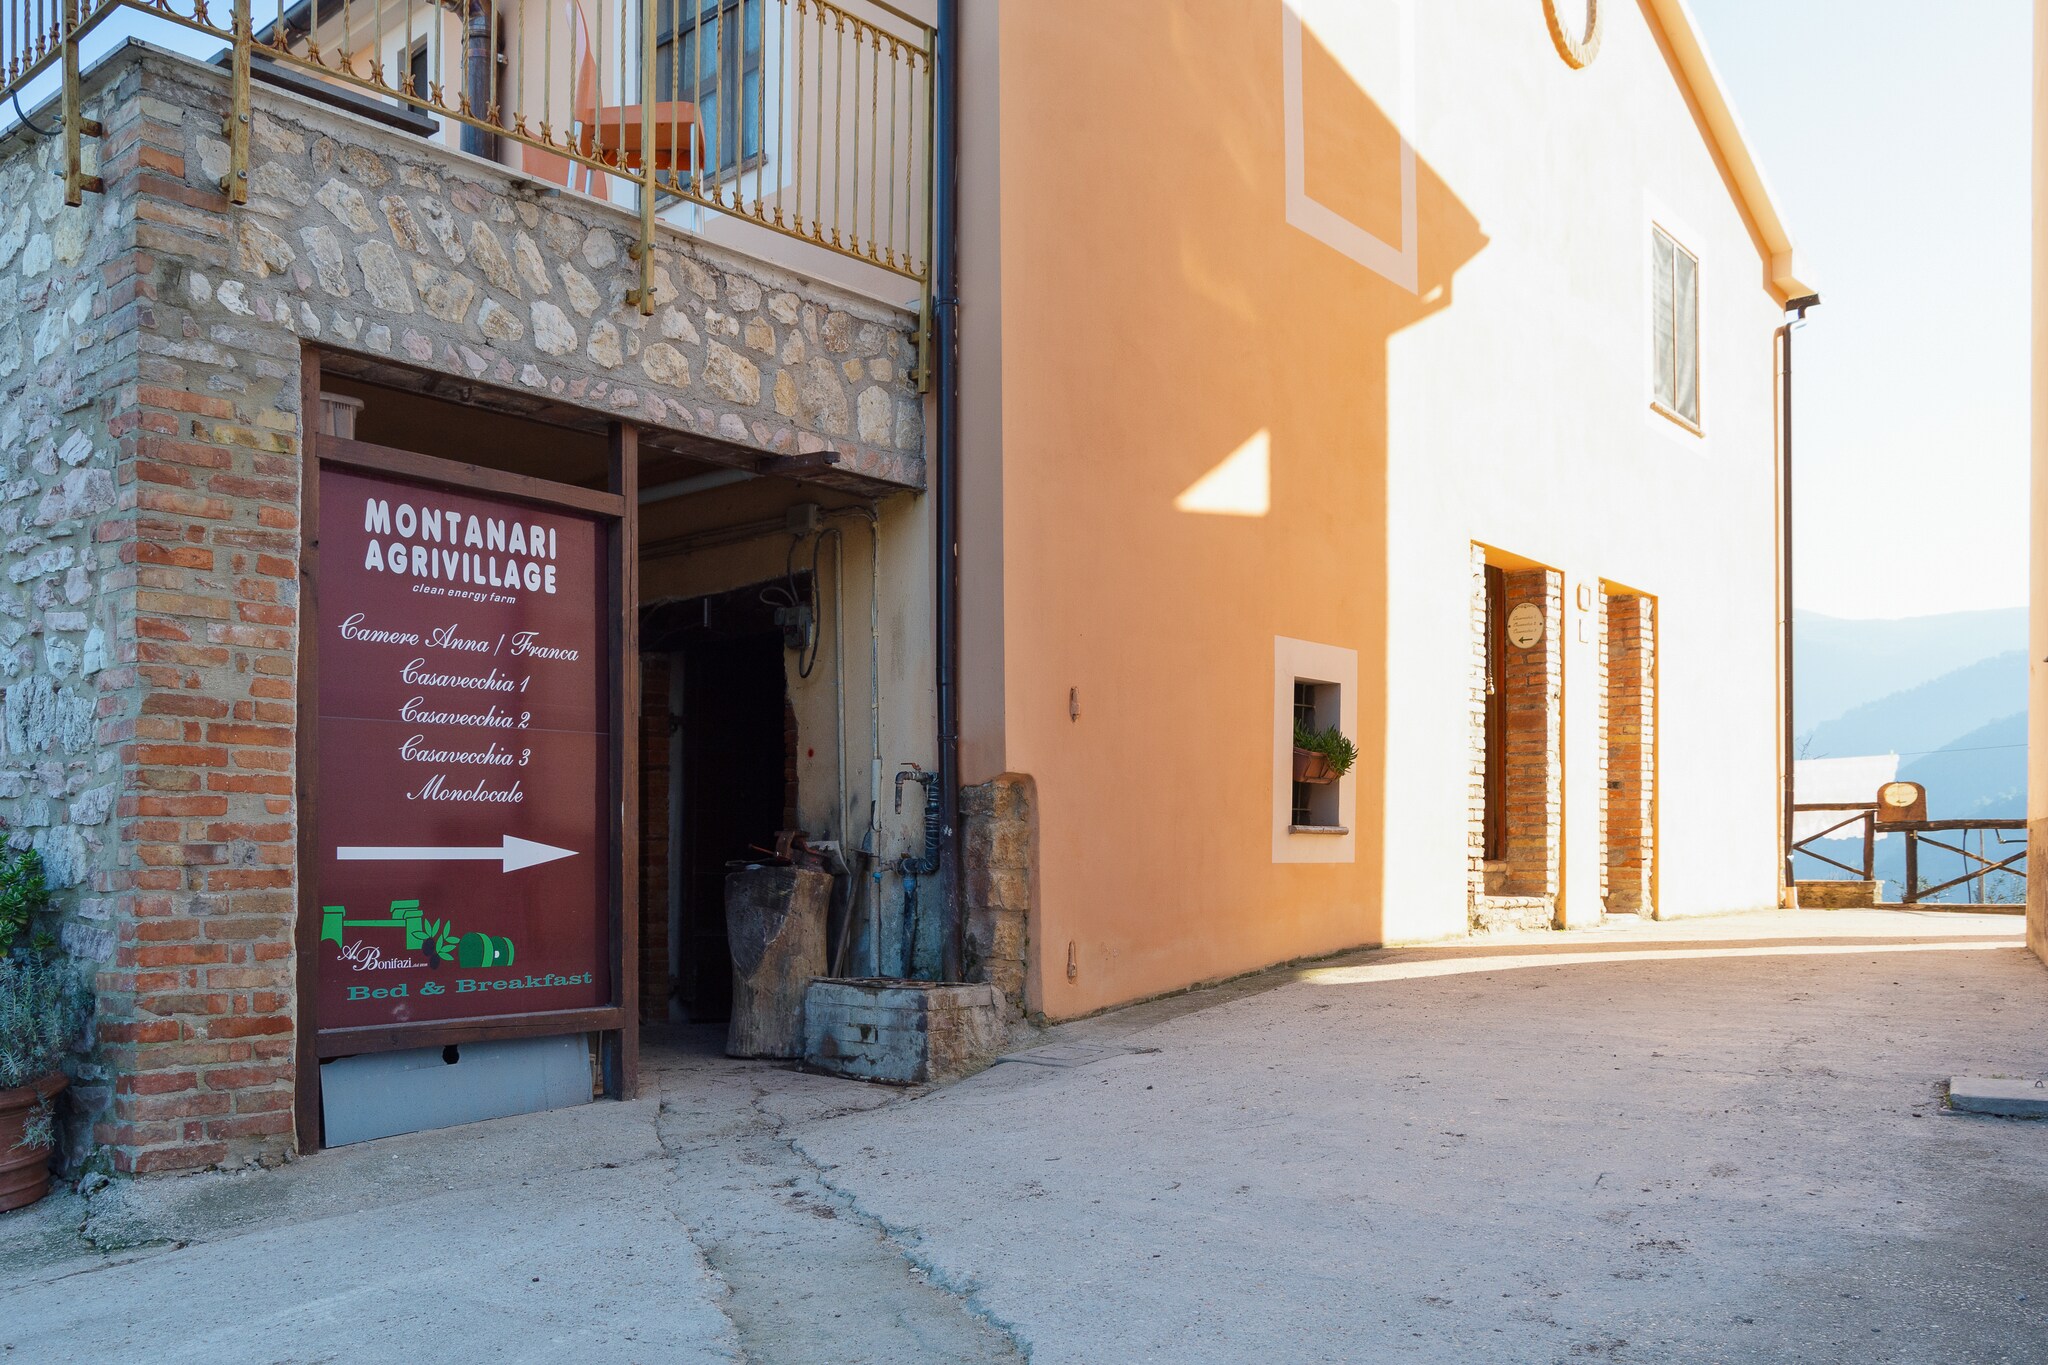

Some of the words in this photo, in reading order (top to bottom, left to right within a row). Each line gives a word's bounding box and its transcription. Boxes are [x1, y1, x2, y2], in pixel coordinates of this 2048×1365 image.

[364, 498, 557, 560] MONTANARI
[364, 539, 557, 594] AGRIVILLAGE
[412, 583, 445, 596] clean
[447, 587, 488, 602] energy
[489, 592, 516, 605] farm
[338, 612, 419, 646] Camere
[425, 623, 489, 653] Anna
[510, 631, 579, 661] Franca
[399, 657, 515, 692] Casavecchia
[520, 675, 531, 693] 1
[398, 696, 514, 729] Casavecchia
[517, 711, 531, 729] 2
[398, 734, 514, 767] Casavecchia
[518, 748, 531, 767] 3
[406, 774, 523, 803] Monolocale
[353, 945, 412, 972] Bonifazi
[347, 983, 409, 1001] Bed
[419, 981, 446, 996] &
[455, 971, 593, 994] Breakfast
